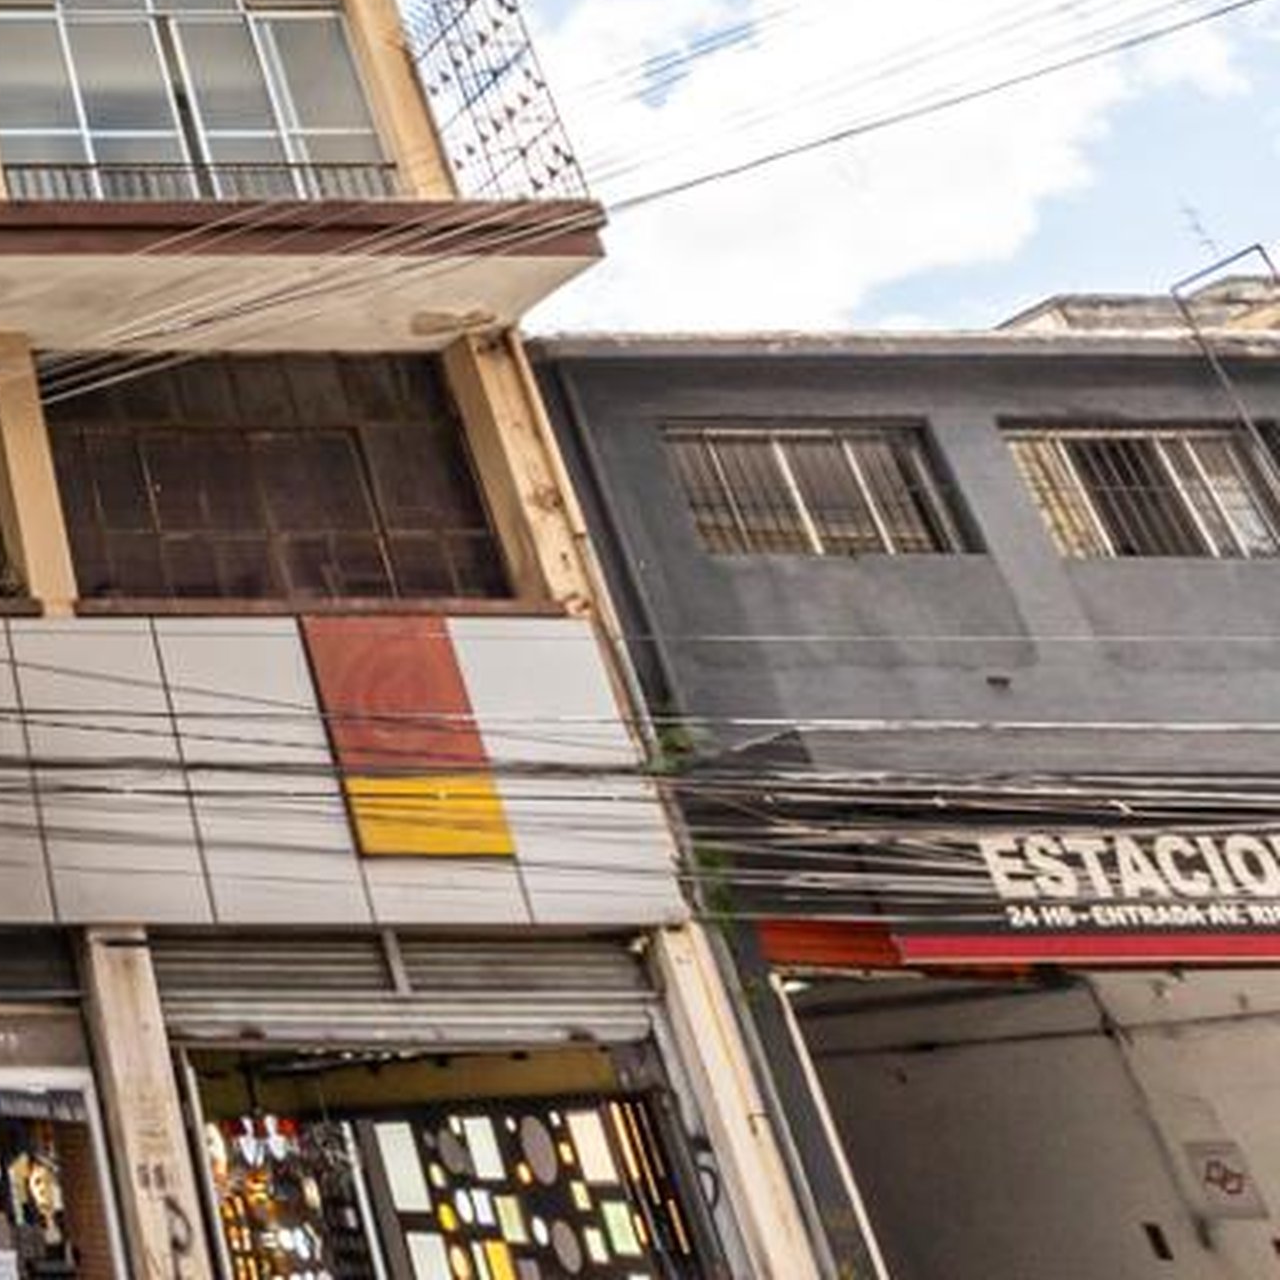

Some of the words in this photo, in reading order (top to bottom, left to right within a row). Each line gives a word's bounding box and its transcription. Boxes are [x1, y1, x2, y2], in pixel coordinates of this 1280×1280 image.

[978, 833, 1280, 898] ESTACIO
[1006, 905, 1038, 927] 24
[1090, 905, 1205, 927] ENTRADA
